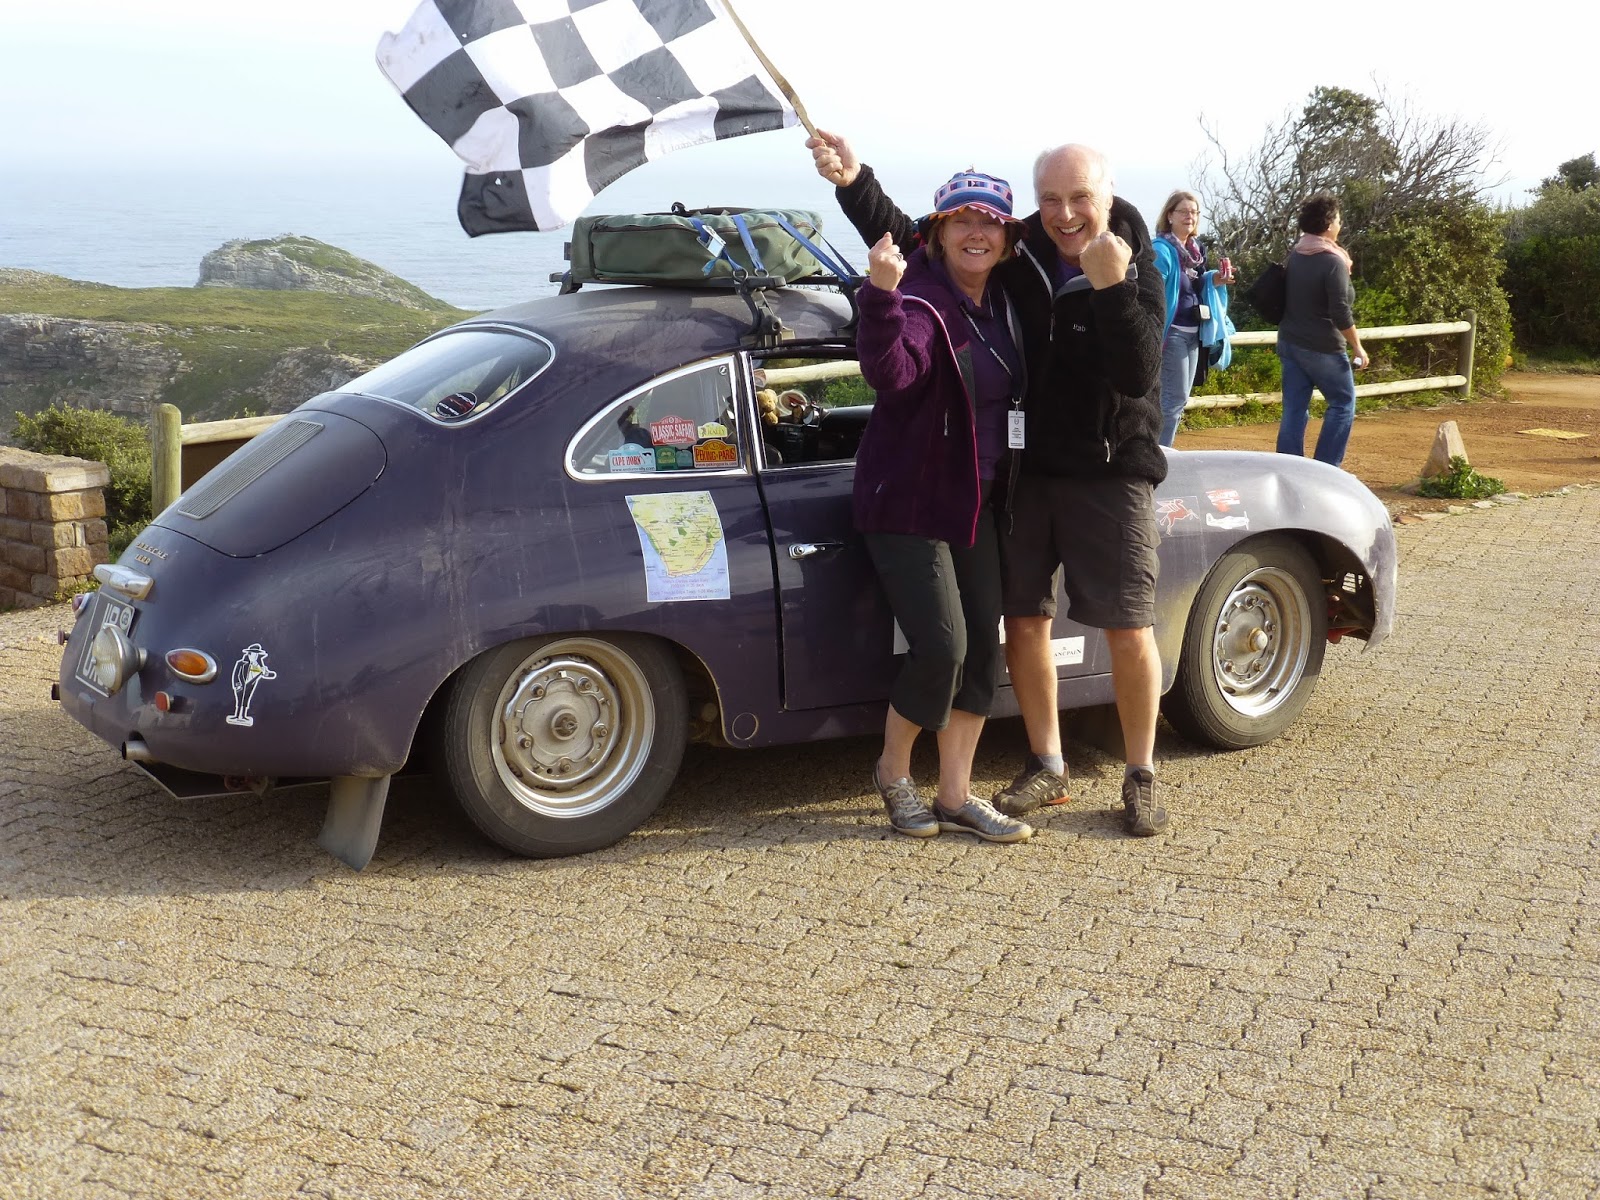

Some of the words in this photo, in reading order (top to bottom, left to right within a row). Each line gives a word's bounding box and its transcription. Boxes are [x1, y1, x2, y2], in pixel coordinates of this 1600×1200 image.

[652, 423, 674, 442] CLASSIC
[674, 422, 695, 439] SAFARI
[695, 448, 717, 461] PEKING
[718, 447, 735, 460] PARIS
[1055, 648, 1082, 657] ANCPAIN
